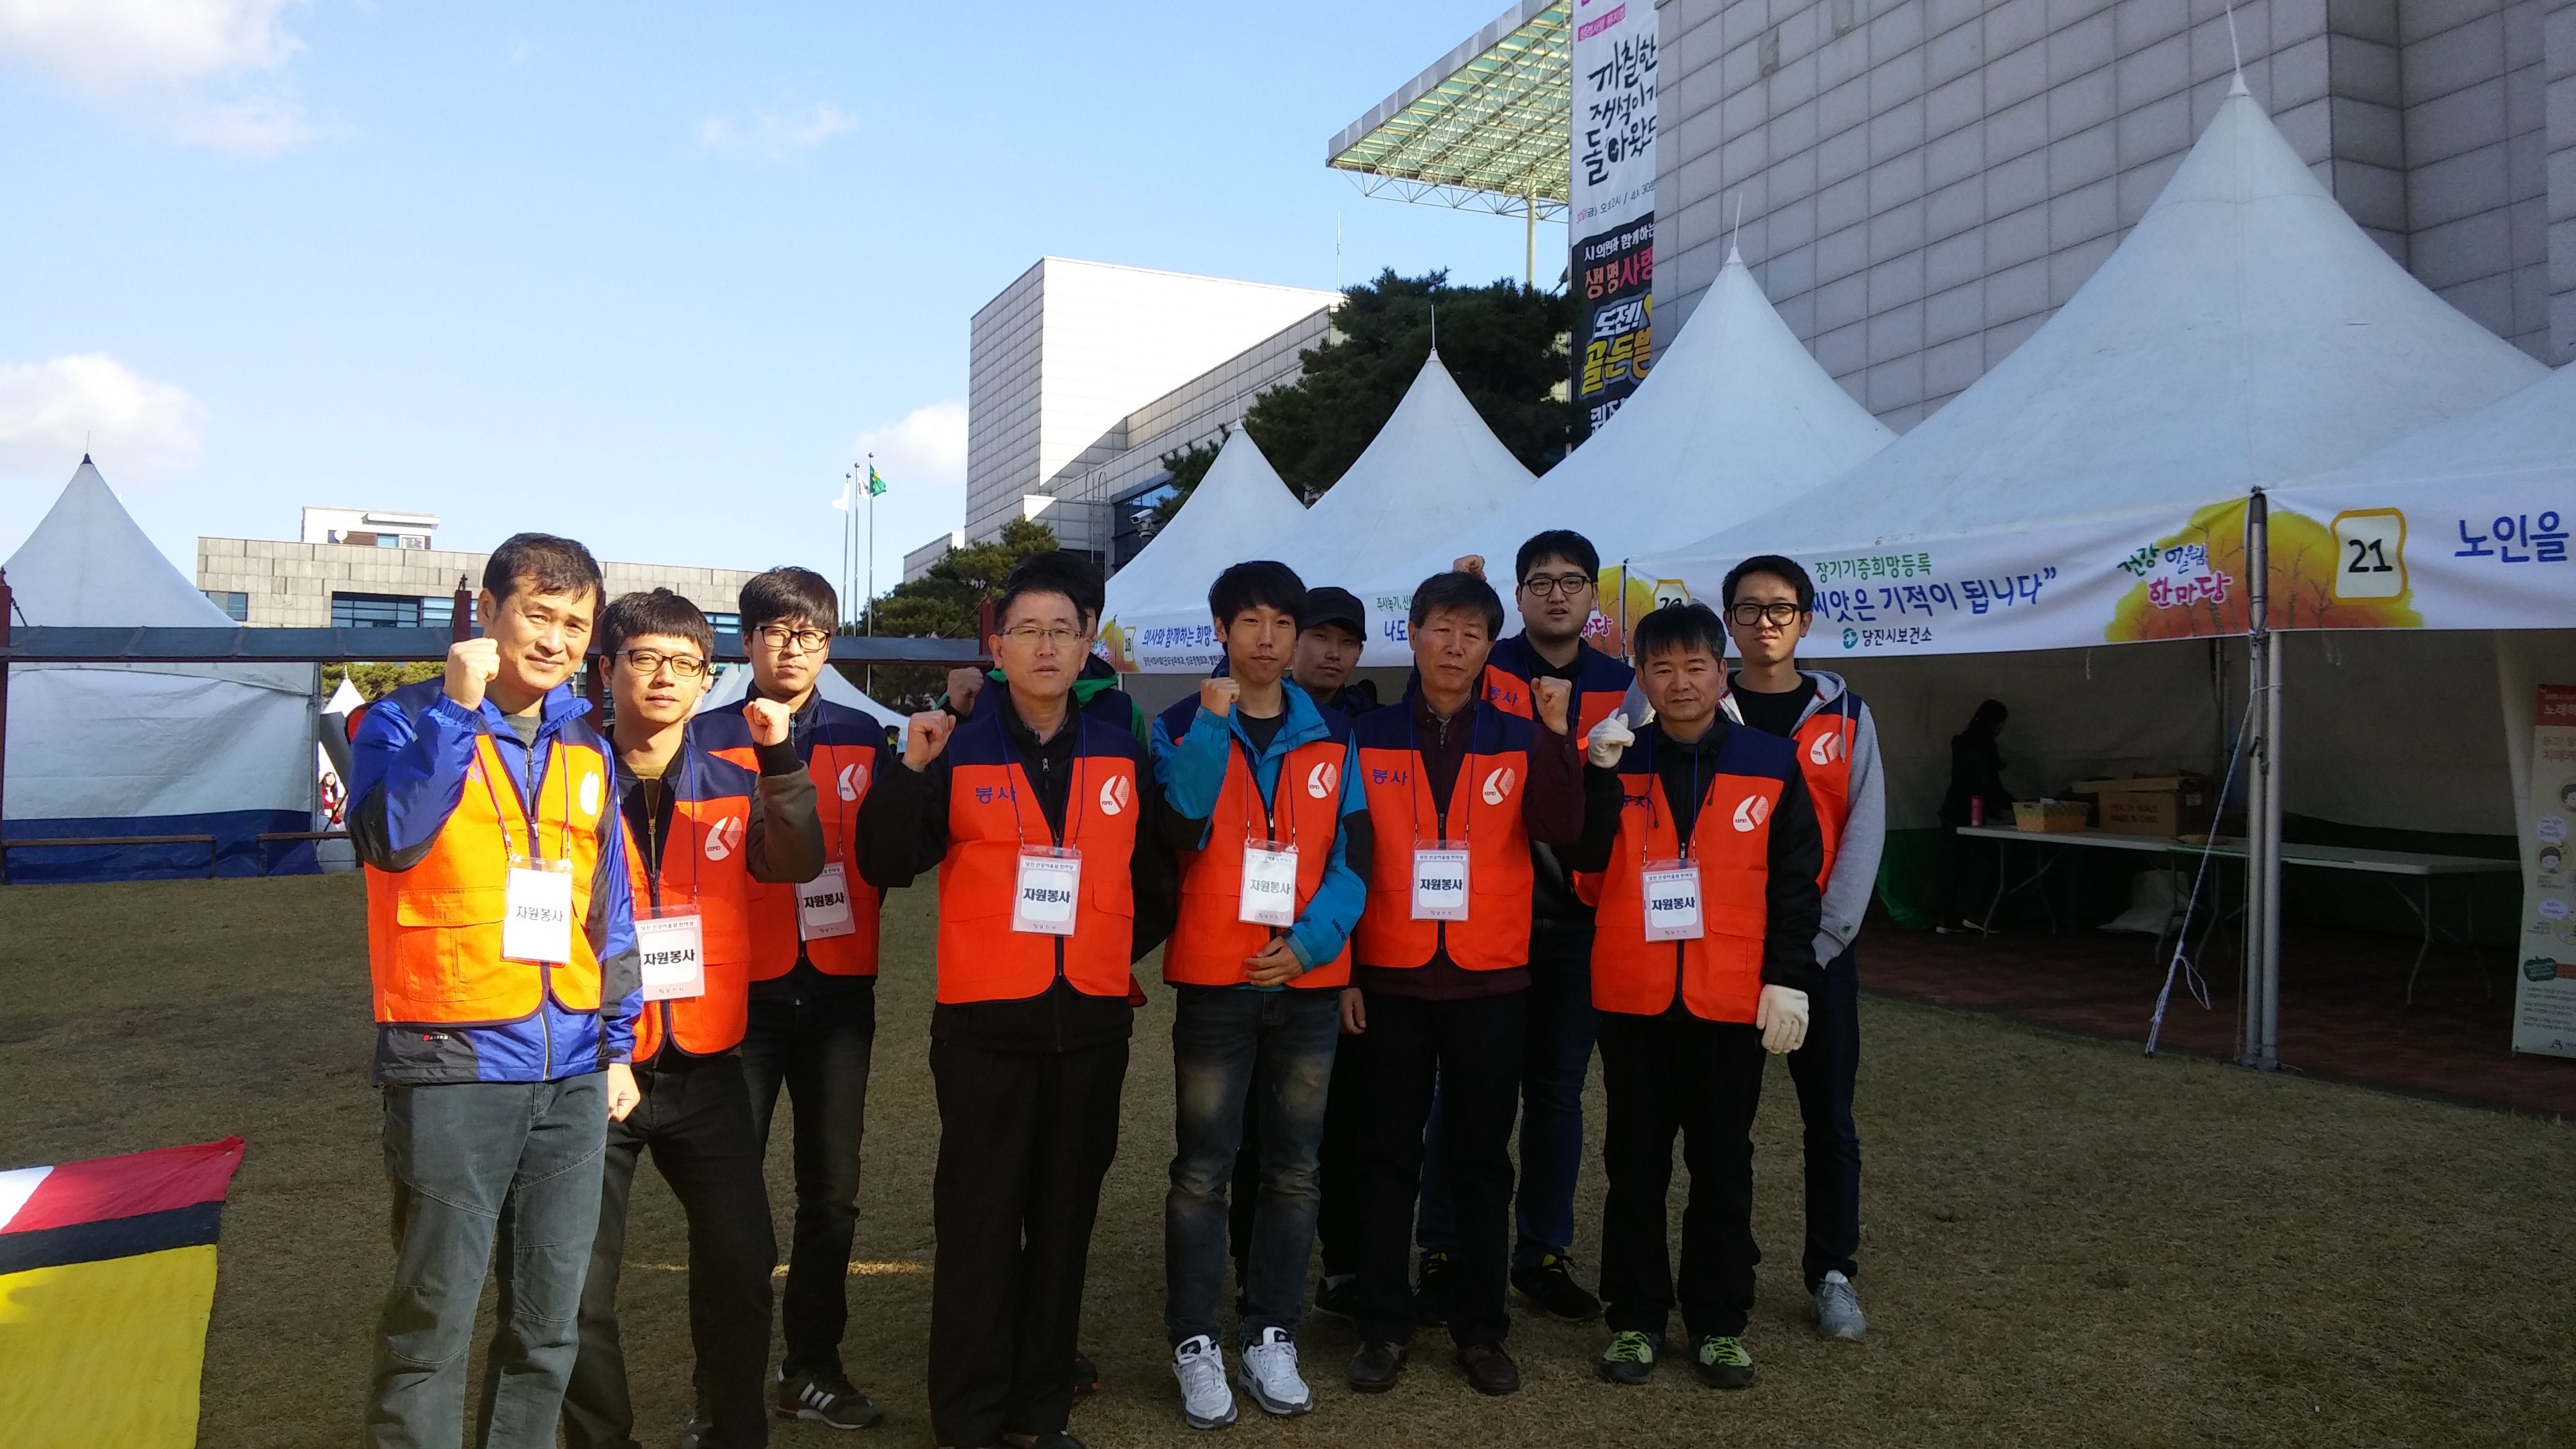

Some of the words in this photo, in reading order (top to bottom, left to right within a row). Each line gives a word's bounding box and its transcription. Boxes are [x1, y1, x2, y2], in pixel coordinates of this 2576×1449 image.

[1587, 33, 1658, 92] 까칠한
[1594, 299, 1643, 339] 도전!
[2454, 511, 2570, 564] 노인을
[2117, 542, 2160, 577] 건강
[2348, 539, 2393, 573] 21
[1814, 552, 1933, 583] 장기기증희망등록
[1879, 582, 1959, 617] 기적이
[2149, 572, 2231, 607] 한마당
[1384, 619, 1408, 642] 나도
[1582, 616, 1612, 636] 마당
[1125, 637, 1131, 652] 18
[1142, 628, 1165, 647] 의사와
[1165, 626, 1194, 648] 함께하는
[1195, 625, 1212, 647] 희망
[1861, 627, 1933, 646] 당진시보건소
[1371, 768, 1408, 786] 봉사
[975, 786, 1016, 804] 봉사
[1250, 879, 1290, 895] 자원봉사
[1419, 879, 1463, 890] 자원봉사
[803, 892, 845, 908] 자원봉사
[1023, 887, 1071, 903] 자원봉사
[1651, 896, 1695, 911] 자원봉사
[643, 949, 695, 965] 자원봉사
